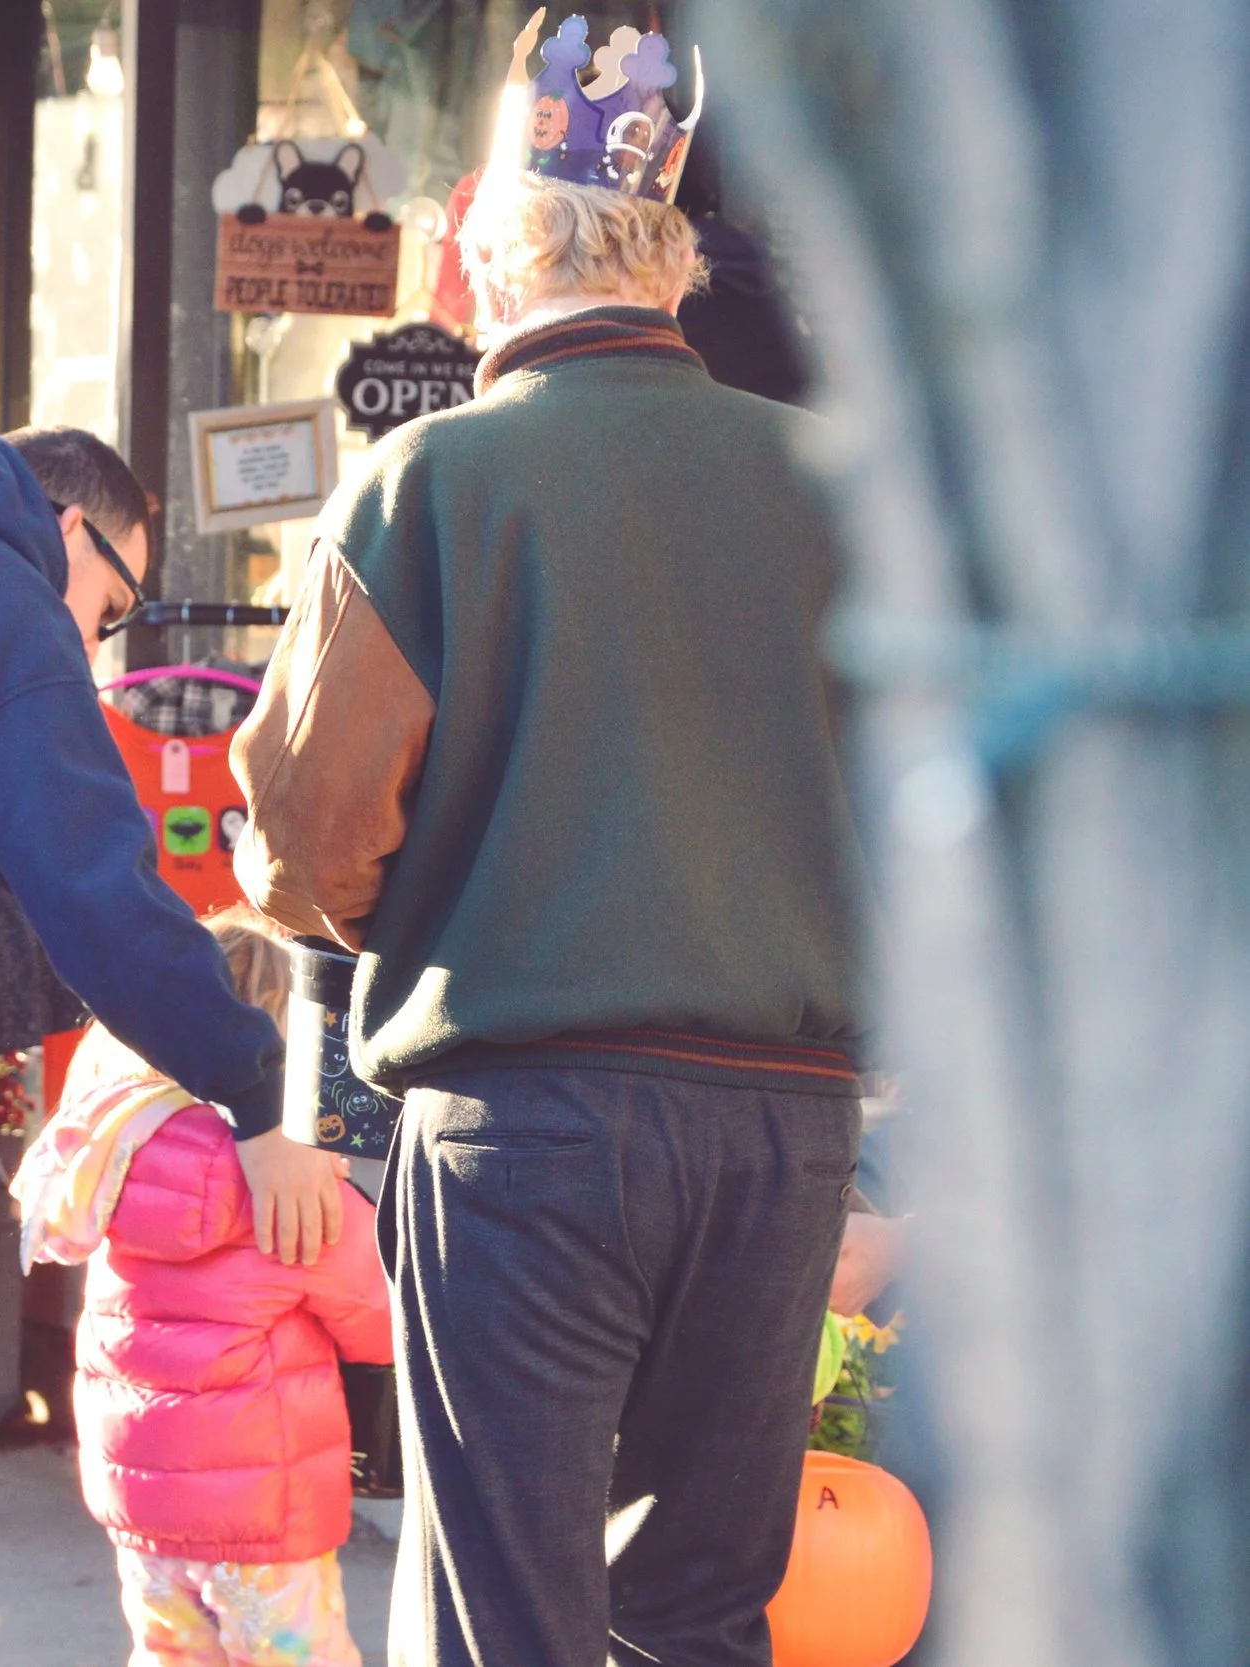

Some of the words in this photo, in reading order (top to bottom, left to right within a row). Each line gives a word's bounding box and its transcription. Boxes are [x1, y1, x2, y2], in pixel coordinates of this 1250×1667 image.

[363, 359, 406, 377] COME
[410, 361, 429, 377] IN
[817, 1486, 839, 1510] A
